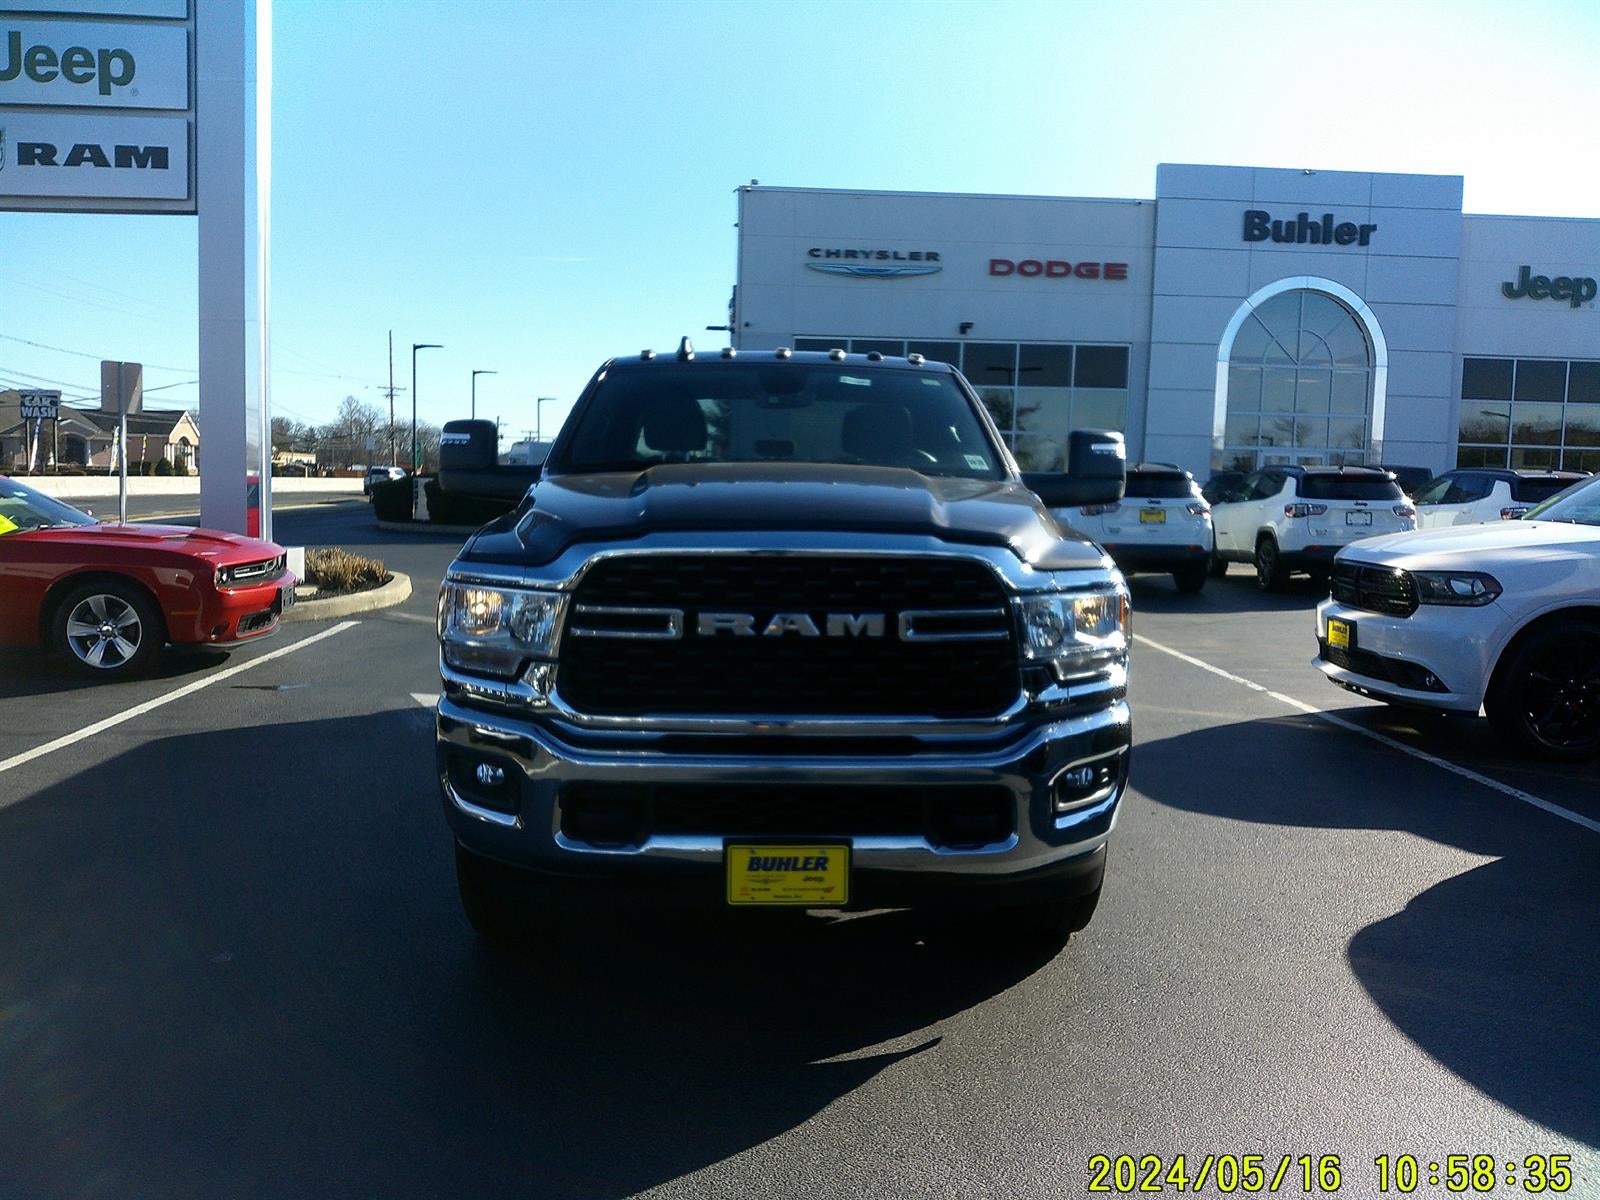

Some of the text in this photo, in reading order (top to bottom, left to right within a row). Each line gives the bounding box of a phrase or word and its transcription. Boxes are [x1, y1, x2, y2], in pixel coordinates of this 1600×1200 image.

[0, 31, 136, 96] Jeep
[17, 142, 169, 169] RAM
[1243, 210, 1377, 246] Buhler
[808, 248, 940, 261] CHRYSLER
[989, 259, 1128, 280] DODGE
[1502, 265, 1597, 308] Jeep
[21, 406, 56, 417] WASH
[697, 612, 885, 637] RAM
[747, 856, 829, 871] BUHLER
